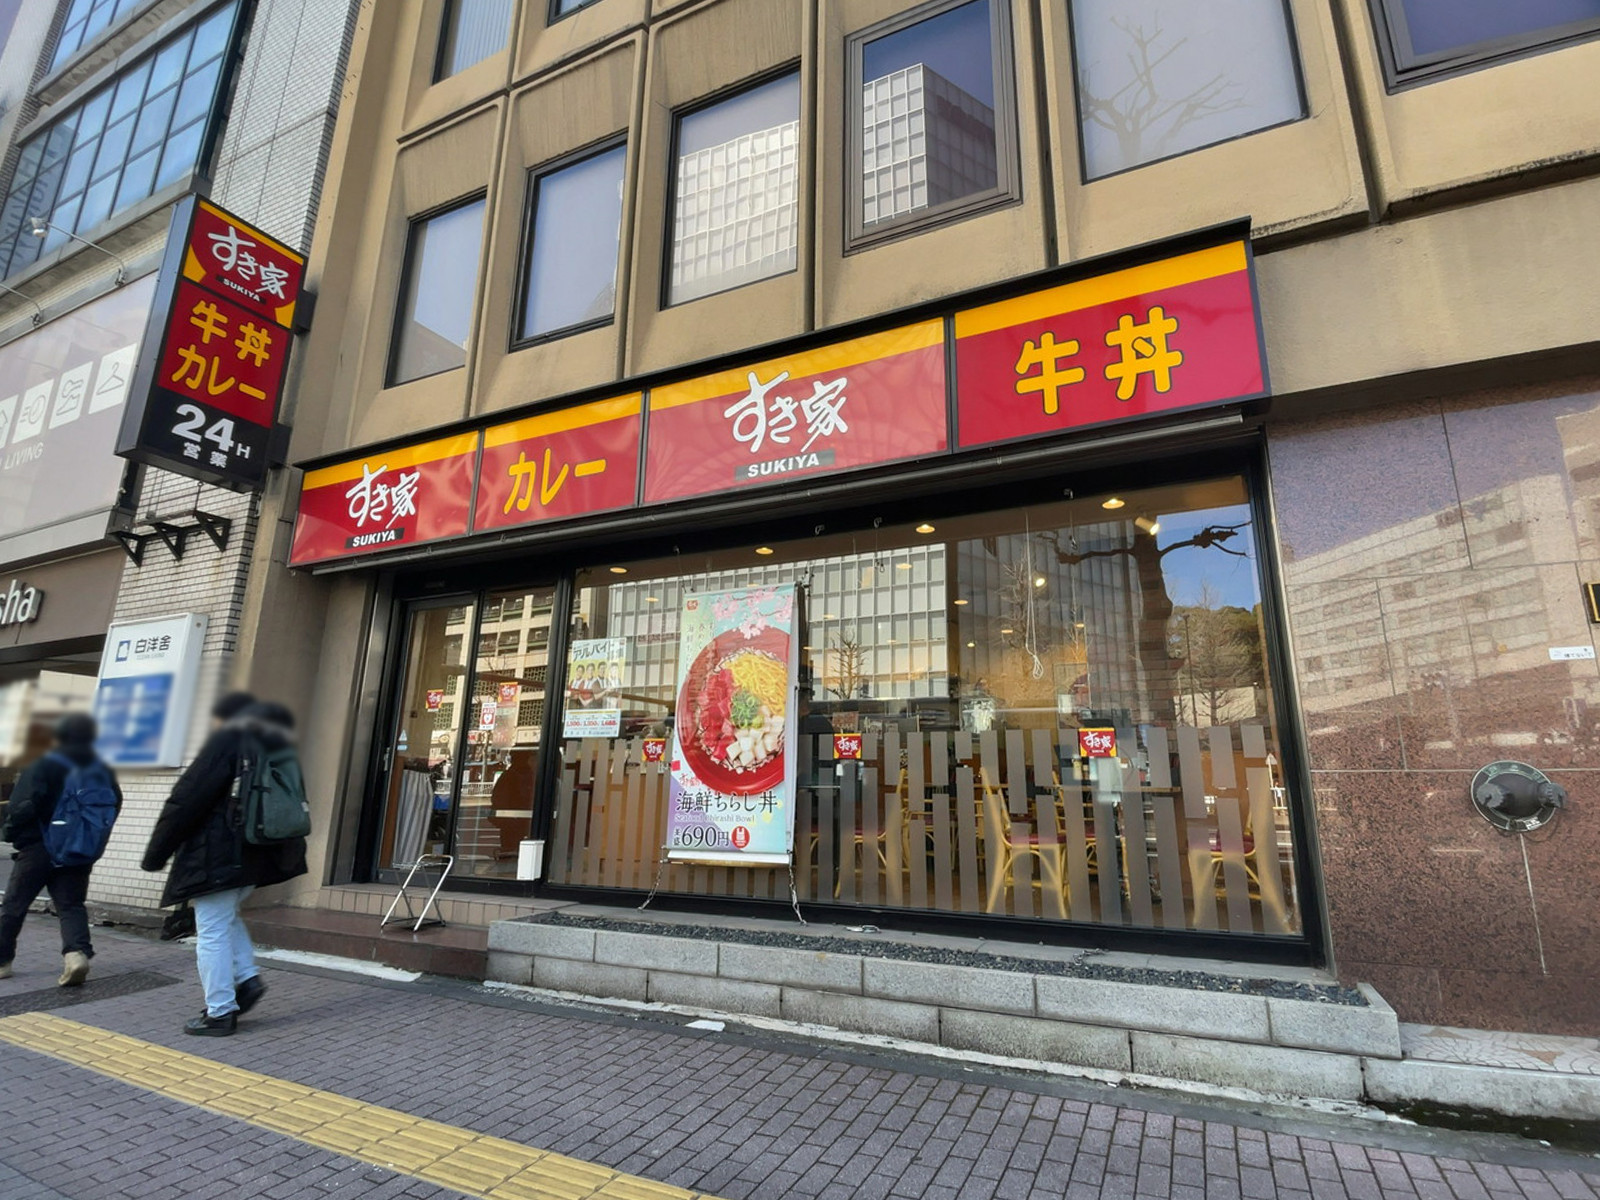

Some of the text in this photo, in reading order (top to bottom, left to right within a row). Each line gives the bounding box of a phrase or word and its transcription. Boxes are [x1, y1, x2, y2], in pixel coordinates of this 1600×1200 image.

[207, 226, 289, 300] すき家
[223, 278, 261, 302] SUKIYA
[189, 300, 272, 368] 牛丼
[171, 344, 267, 401] カレー
[1014, 305, 1184, 416] 牛丼
[723, 370, 848, 454] すき家
[4, 441, 44, 470] LIVING
[183, 441, 229, 469] 営業
[747, 452, 820, 478] SUKIYA
[503, 447, 607, 516] カレー
[345, 463, 421, 529] すき家
[352, 529, 397, 548] SUKIYA
[134, 634, 173, 654] 白洋舎
[1083, 731, 1112, 750] すき家
[676, 790, 777, 813] 海鮮ちらし丼
[682, 826, 729, 847] 690円
